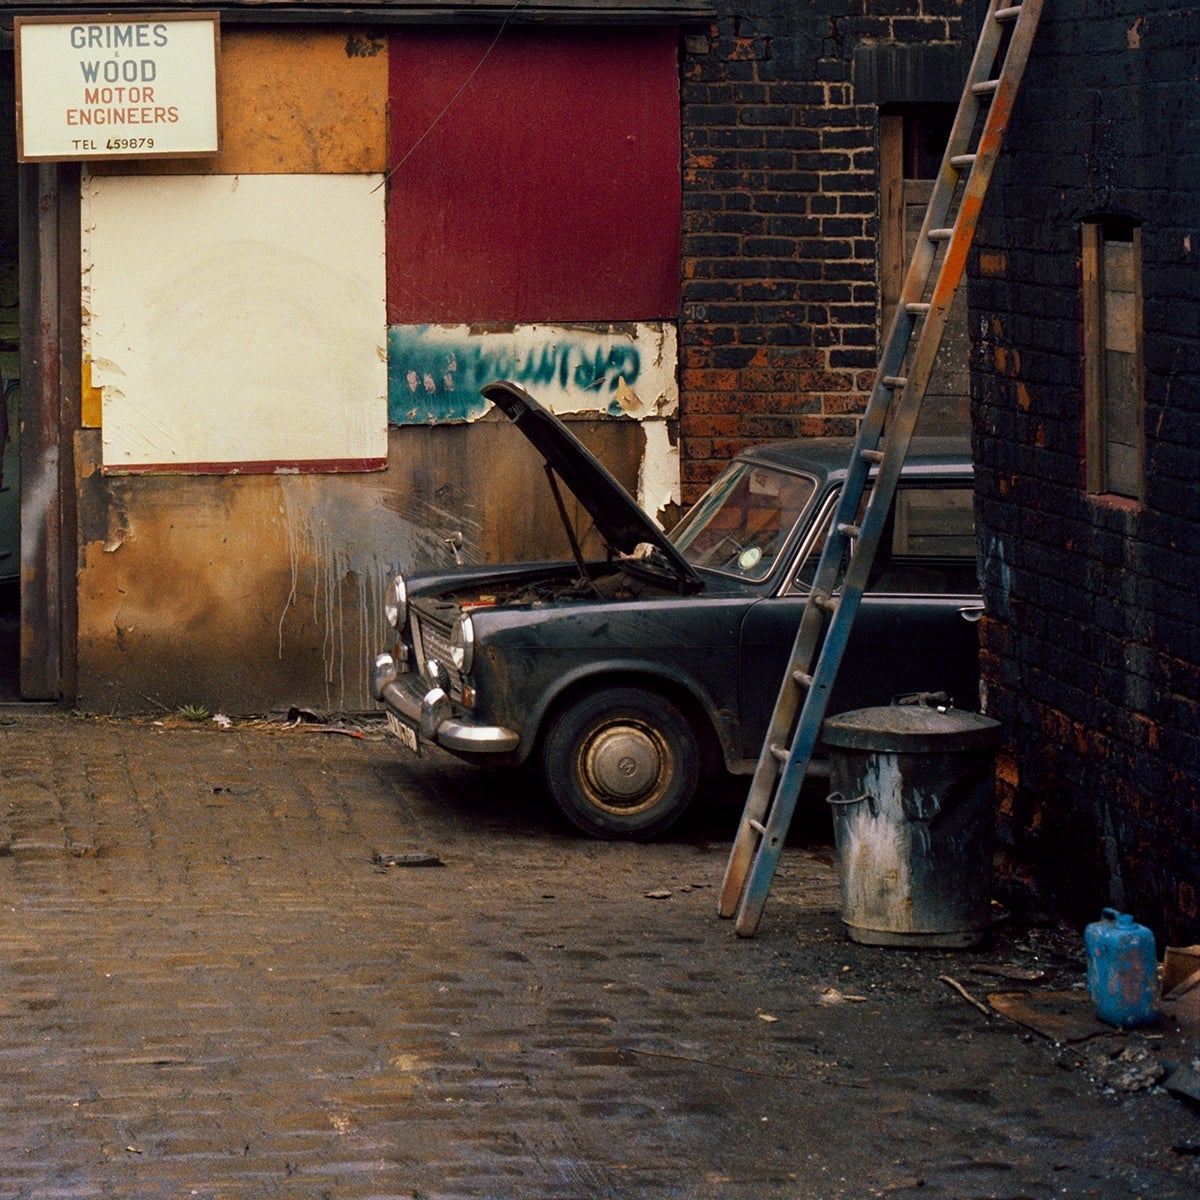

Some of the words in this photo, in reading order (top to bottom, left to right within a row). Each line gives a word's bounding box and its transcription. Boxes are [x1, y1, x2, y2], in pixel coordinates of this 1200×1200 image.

[70, 24, 168, 49] GRIMES
[79, 59, 157, 84] WOOD
[84, 86, 155, 105] MOTOR
[66, 106, 180, 126] ENGINEERS
[71, 139, 97, 151] TEL
[105, 137, 155, 151] 459879
